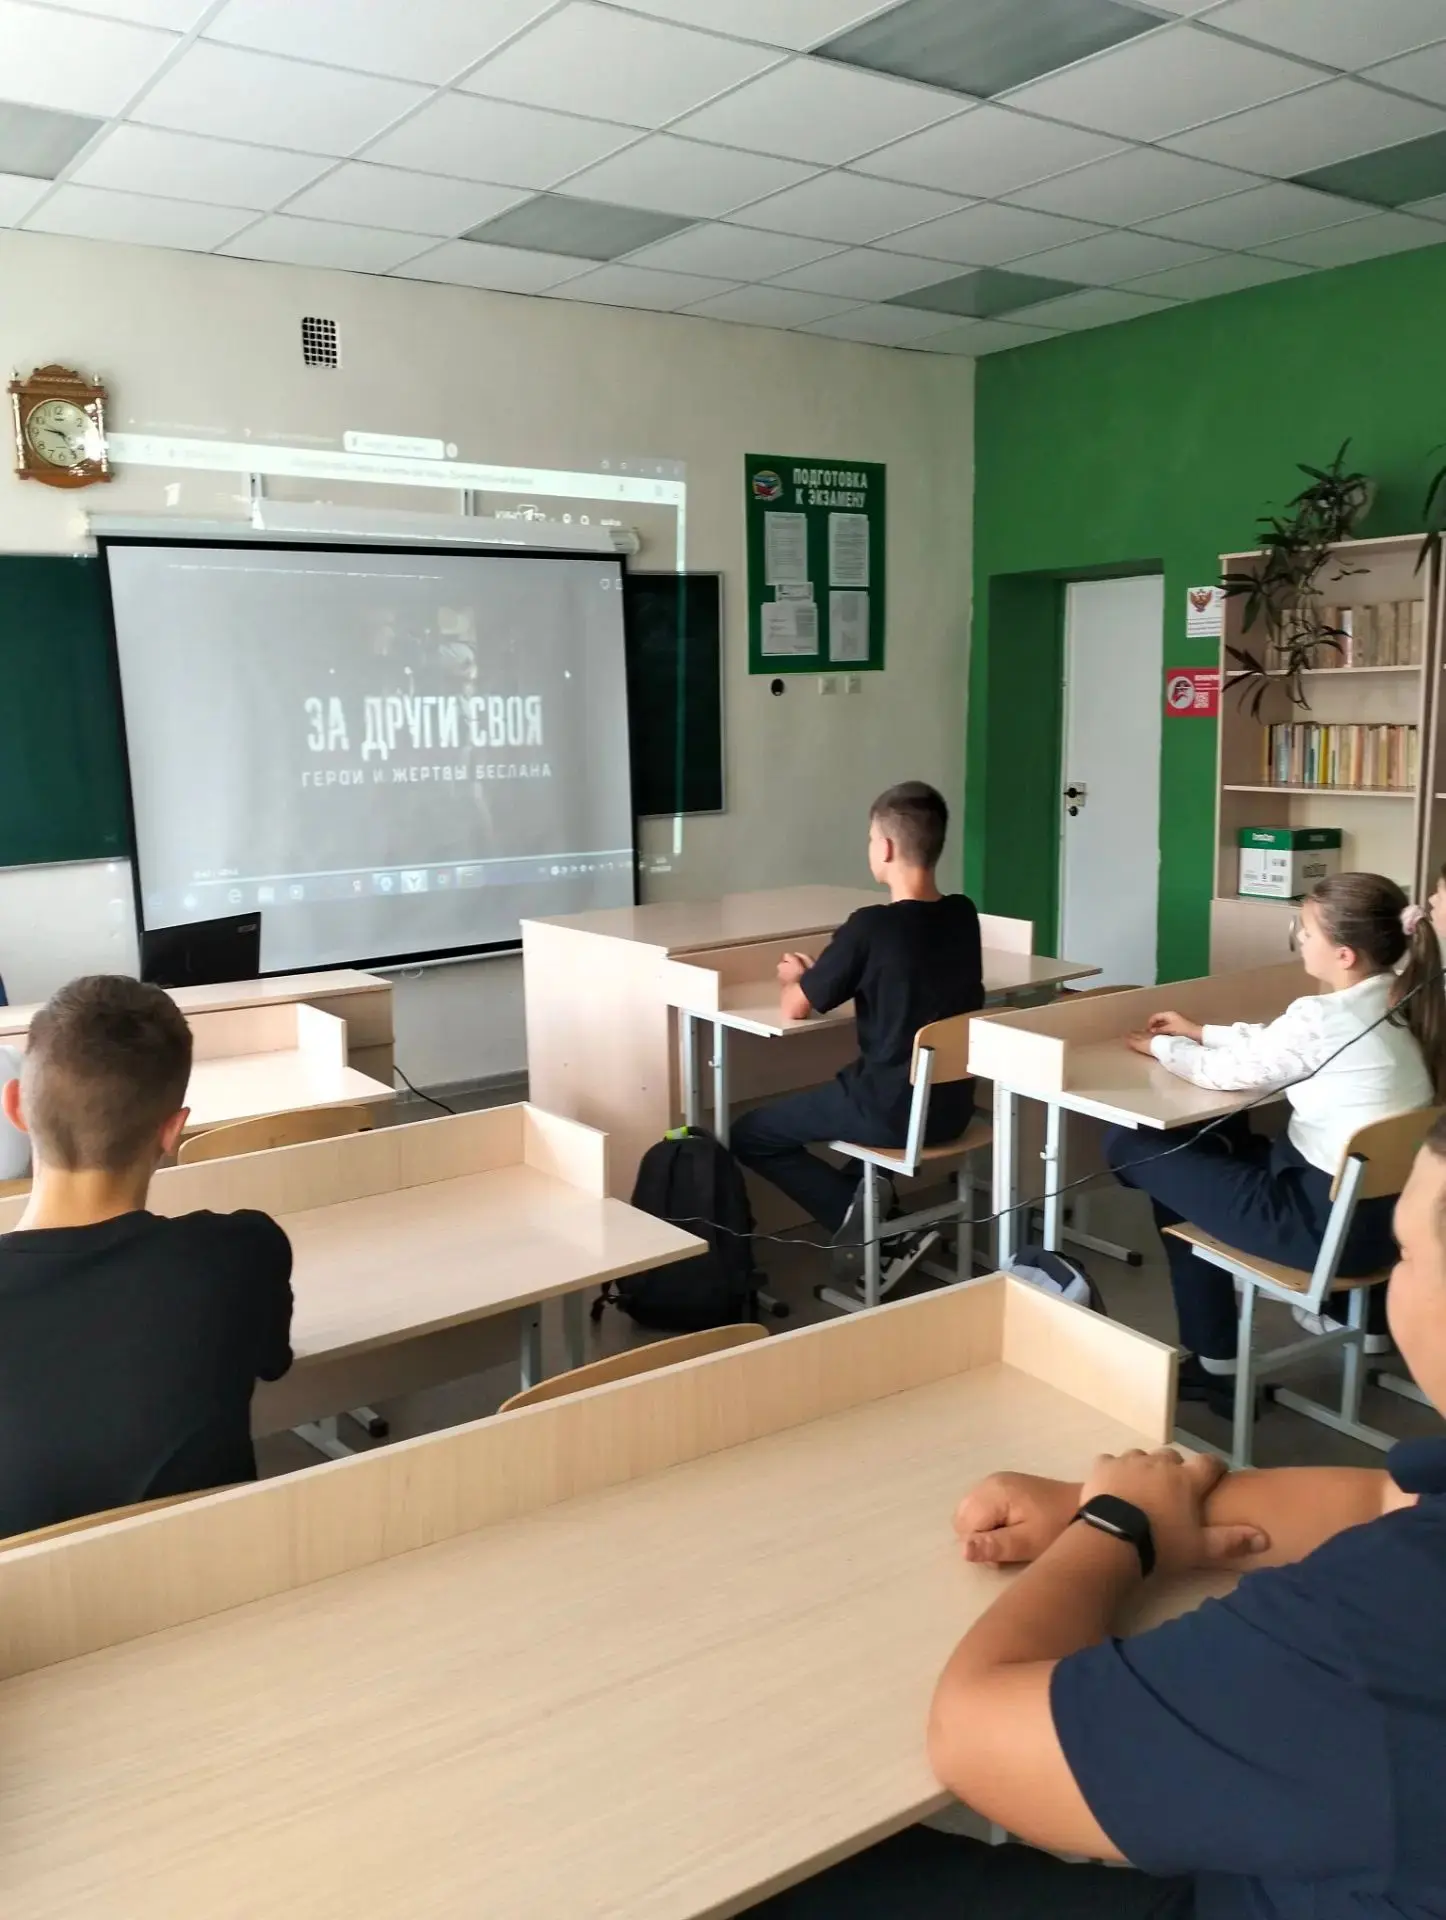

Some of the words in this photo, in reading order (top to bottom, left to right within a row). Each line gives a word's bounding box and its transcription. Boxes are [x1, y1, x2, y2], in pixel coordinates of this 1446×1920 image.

[793, 468, 868, 489] ПОДГОТОВКА
[795, 488, 804, 505] К
[808, 489, 866, 508] ЭКЗАМЕНУ
[304, 696, 350, 751] ЗА
[361, 695, 459, 761] ДРУГИ
[470, 696, 543, 747] СВОЯ
[302, 769, 364, 787] ГЕРОИ
[373, 769, 386, 784] И
[392, 764, 467, 783] ЖЕРТВЫ
[475, 763, 551, 780] БЕСЛАНА
